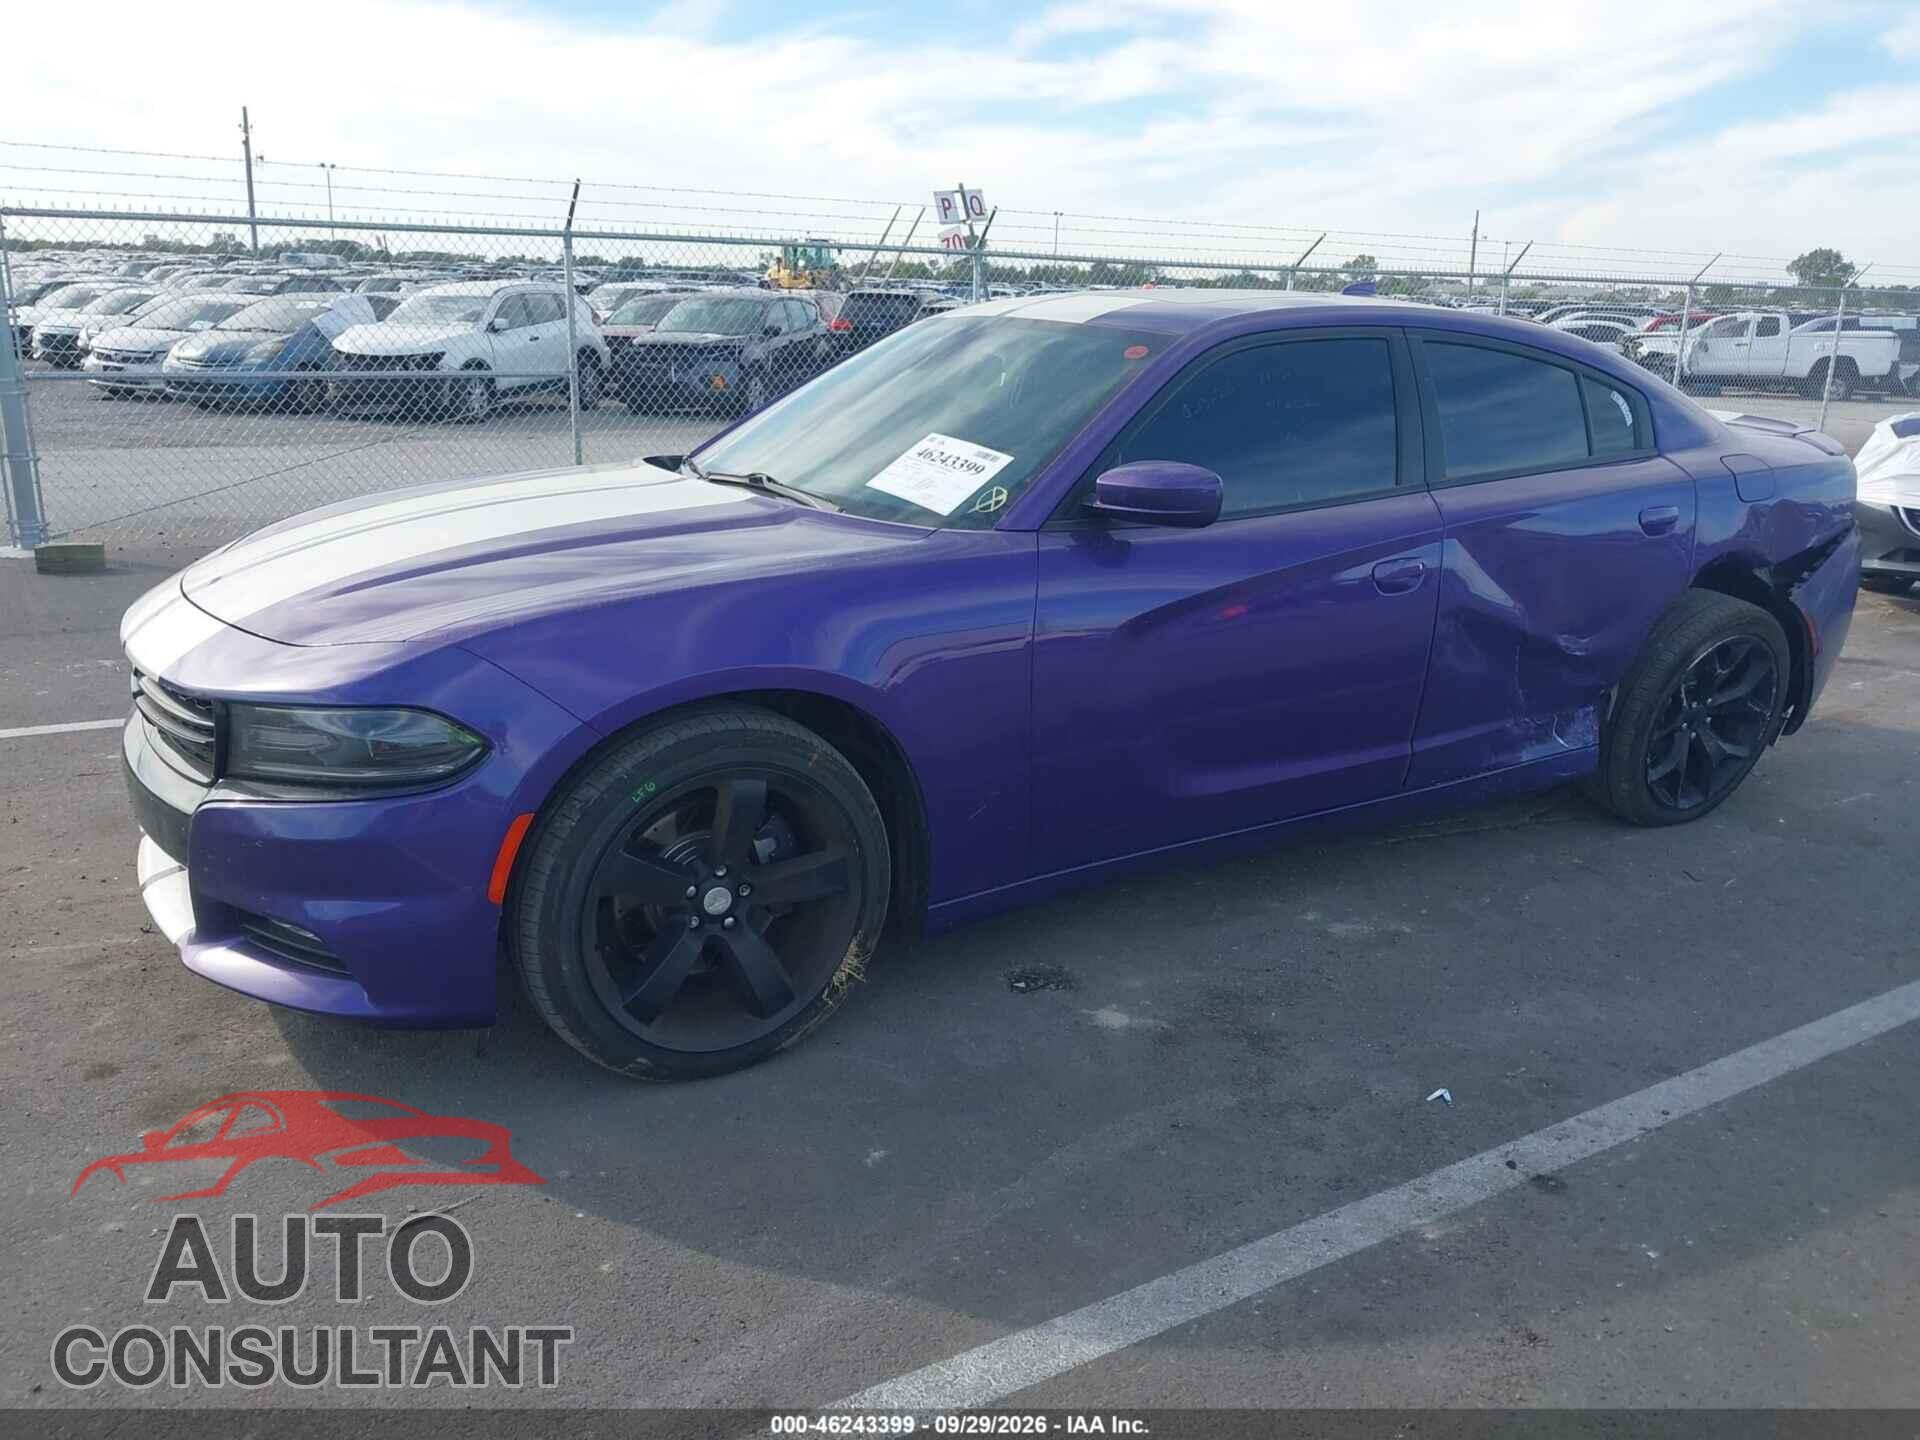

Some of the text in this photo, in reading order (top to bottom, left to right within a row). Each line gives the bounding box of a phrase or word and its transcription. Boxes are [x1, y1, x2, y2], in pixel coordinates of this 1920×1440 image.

[940, 197, 952, 220] P
[969, 195, 985, 217] Q
[916, 447, 986, 475] 46243399
